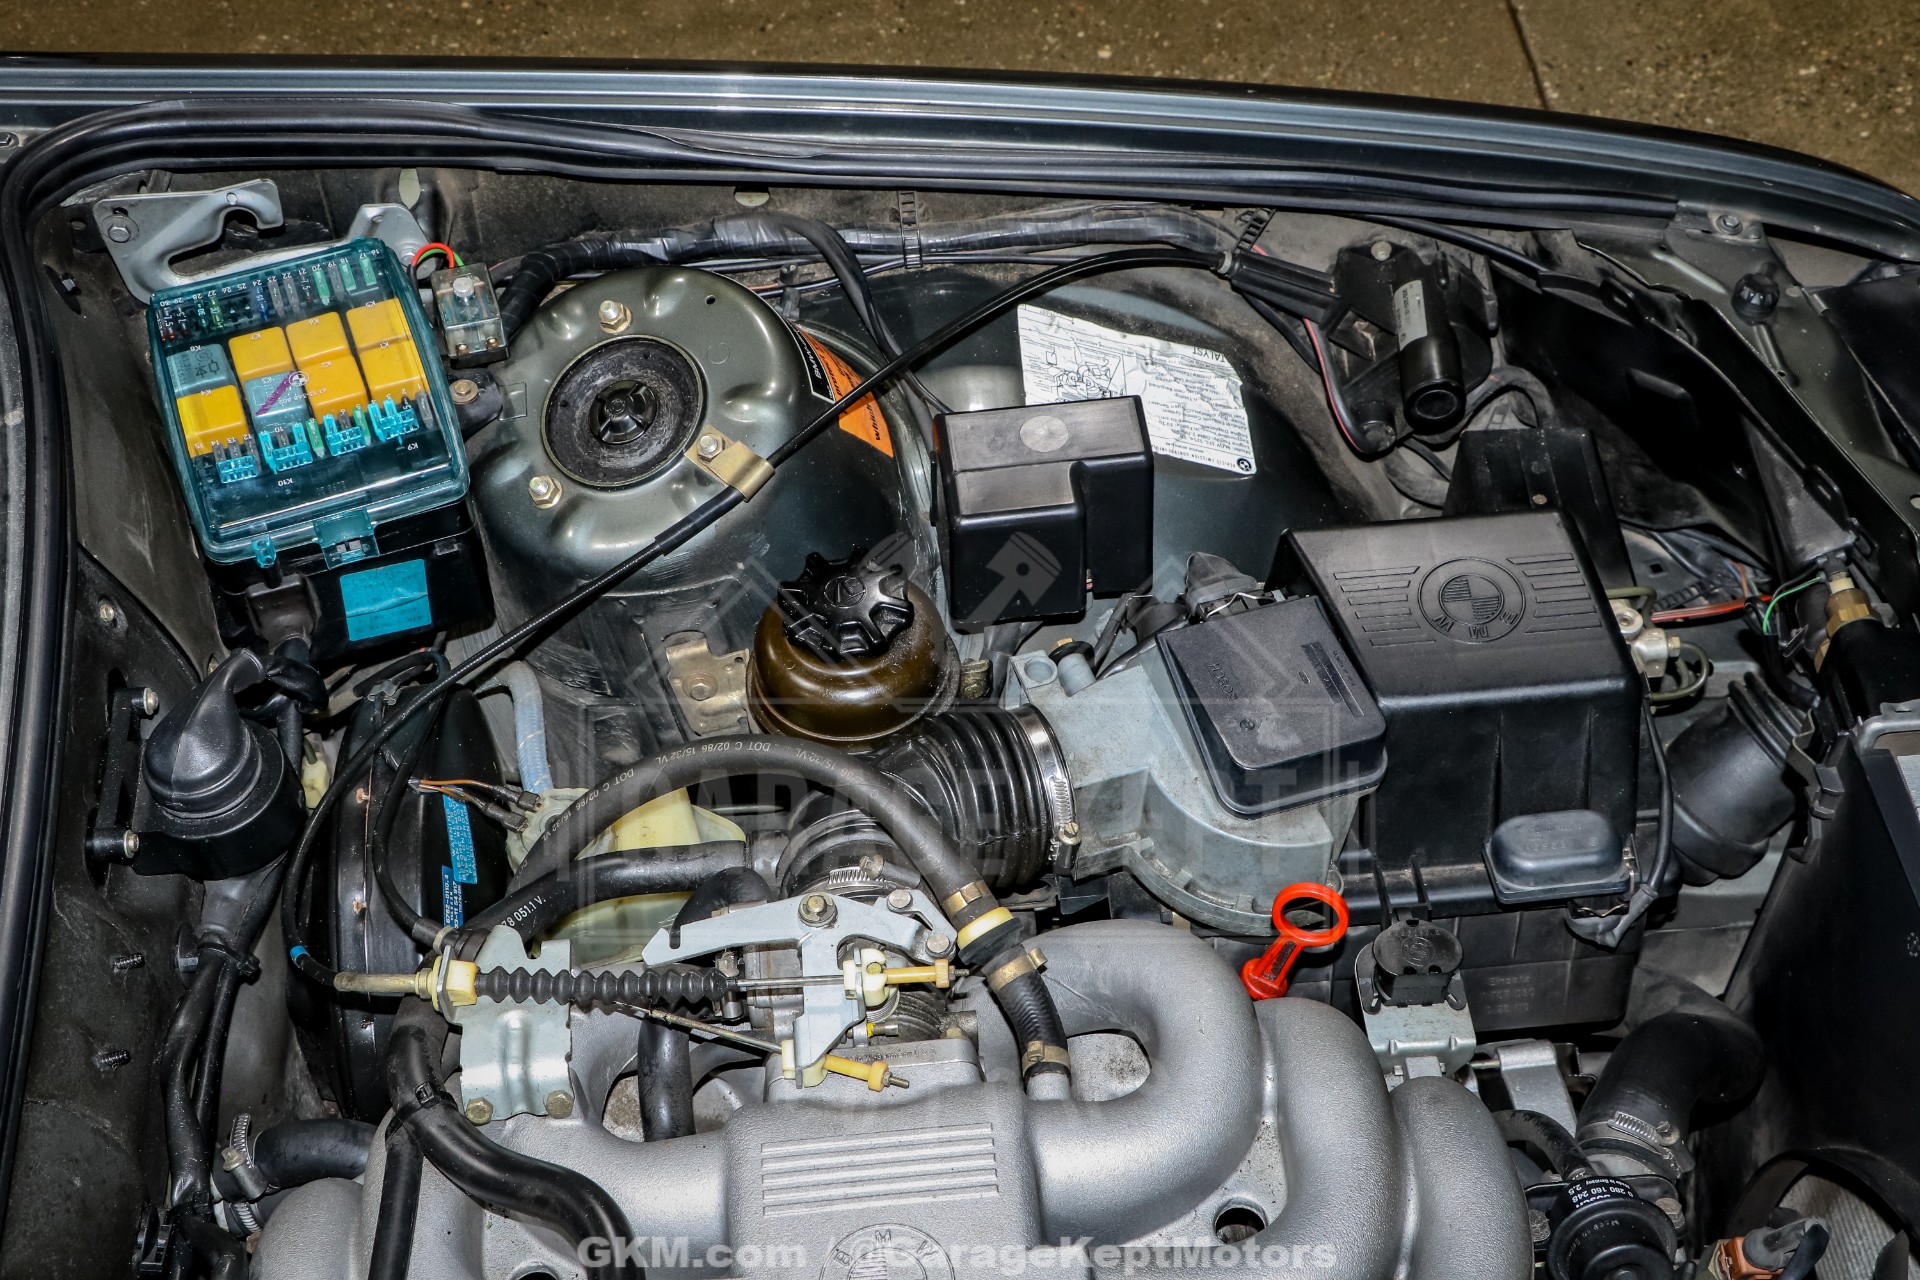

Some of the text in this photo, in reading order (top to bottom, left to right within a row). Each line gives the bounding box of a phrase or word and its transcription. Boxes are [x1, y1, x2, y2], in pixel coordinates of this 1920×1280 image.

[339, 256, 349, 264] 18
[297, 267, 306, 275] 21
[310, 263, 321, 271] 20
[266, 274, 277, 283] 23
[281, 271, 292, 279] 22
[236, 282, 247, 290] 25
[251, 278, 262, 286] 24
[206, 289, 216, 297] 27
[220, 285, 231, 294] 26
[191, 292, 202, 300] 28
[188, 299, 376, 352] K5 K6 K7 K8
[378, 340, 390, 349] K1
[319, 359, 332, 368] K2
[199, 387, 212, 397] K4
[273, 424, 284, 433] 10
[225, 435, 236, 444] 13
[242, 432, 252, 440] 12
[209, 438, 220, 447] 14
[405, 441, 419, 451] K9
[276, 476, 293, 487] K10
[654, 740, 771, 765] DOT C 02/86 15/32 VL
[512, 899, 537, 922] 051.1
[1589, 1185, 1607, 1195] 160
